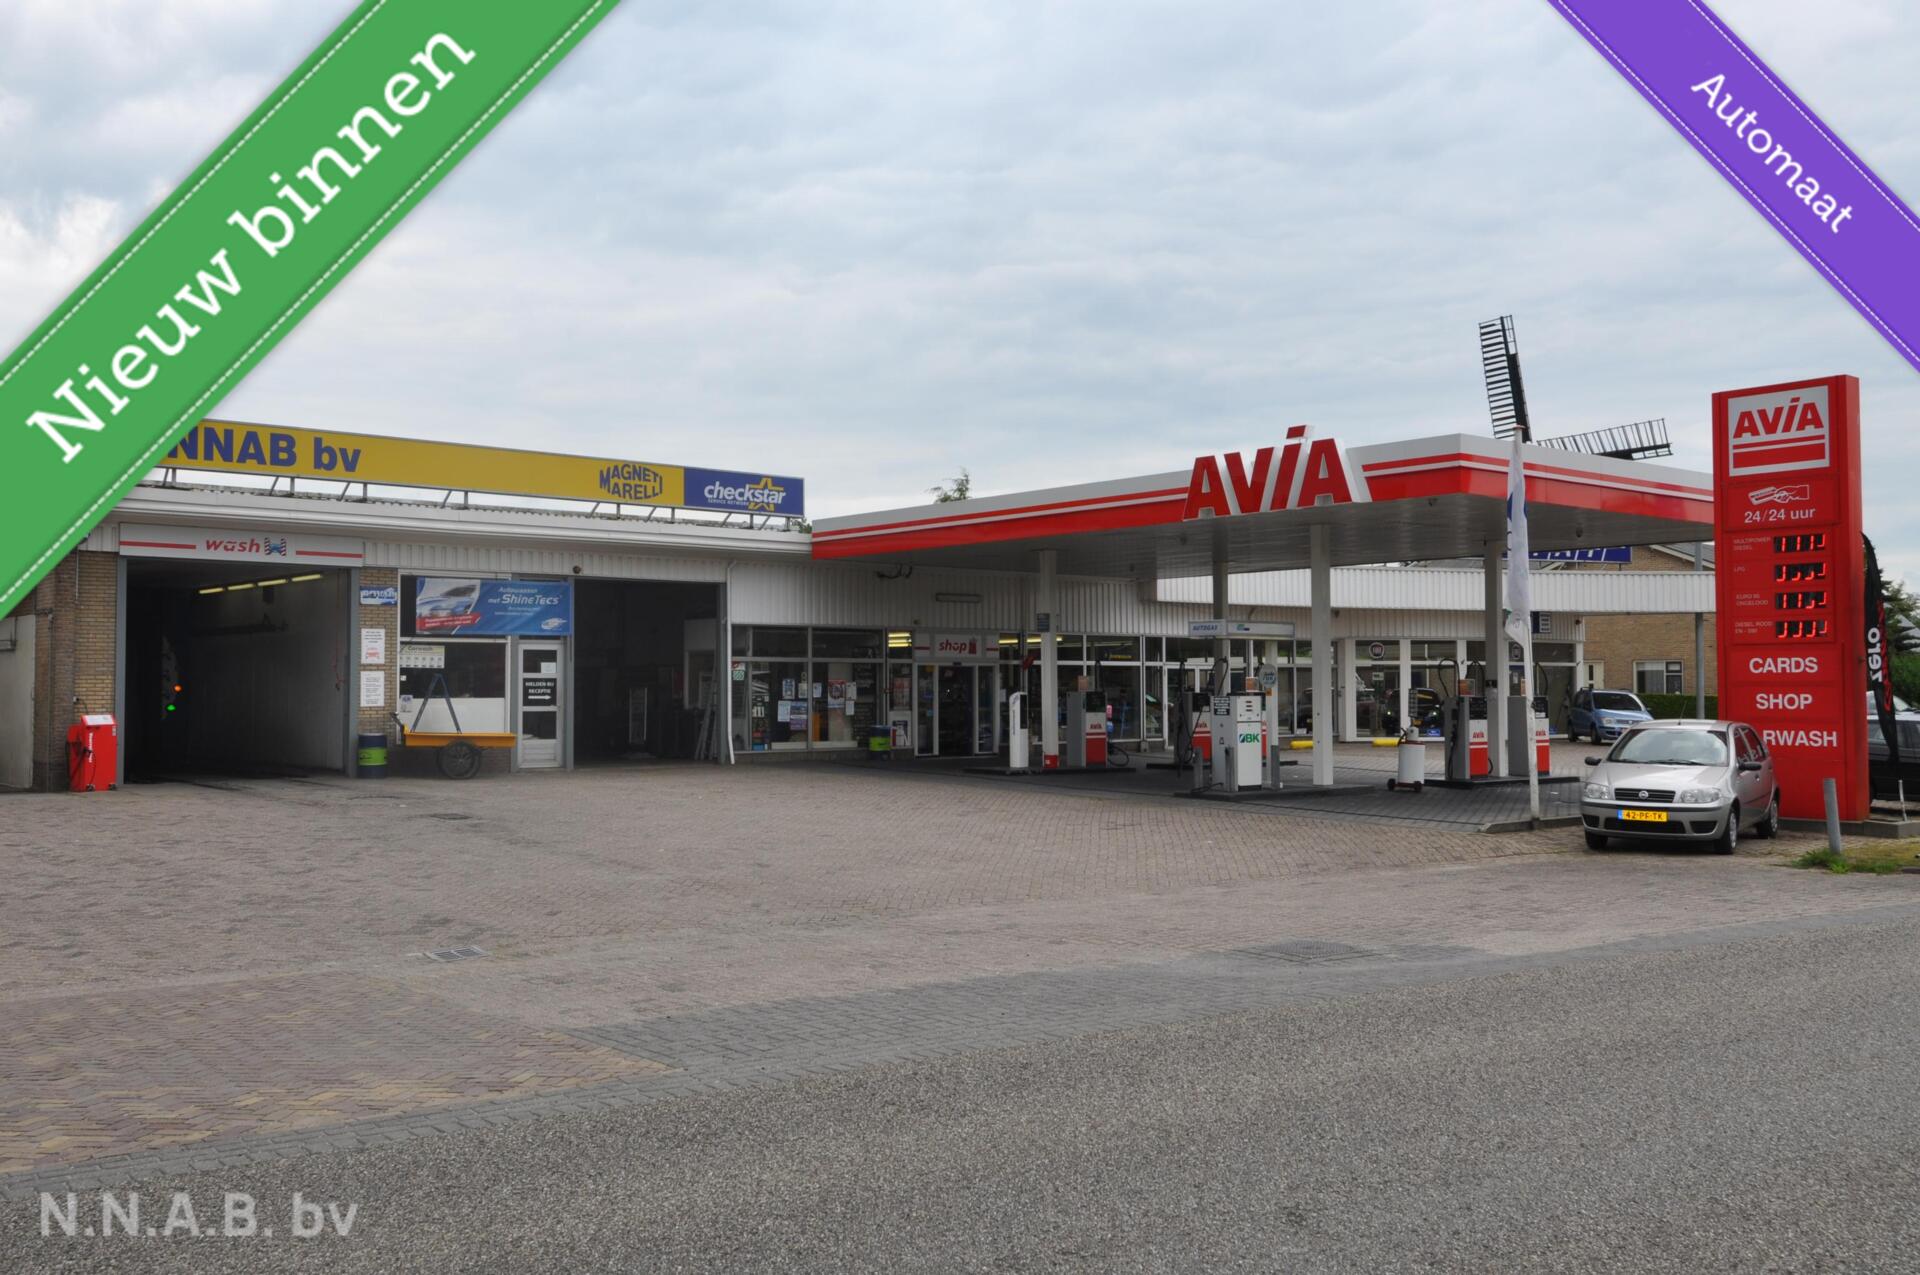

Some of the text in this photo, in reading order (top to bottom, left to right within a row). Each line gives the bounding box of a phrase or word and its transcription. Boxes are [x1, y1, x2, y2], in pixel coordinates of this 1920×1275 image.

[313, 436, 361, 472] bv
[600, 463, 663, 489] MAGNETI
[600, 475, 663, 500] MARELLI
[704, 480, 786, 505] checkstar
[1744, 508, 1816, 524] 24/24 uur
[205, 538, 261, 553] wash
[939, 638, 967, 654] shop
[1749, 656, 1818, 674] CARDS
[1755, 693, 1813, 710] SHOP
